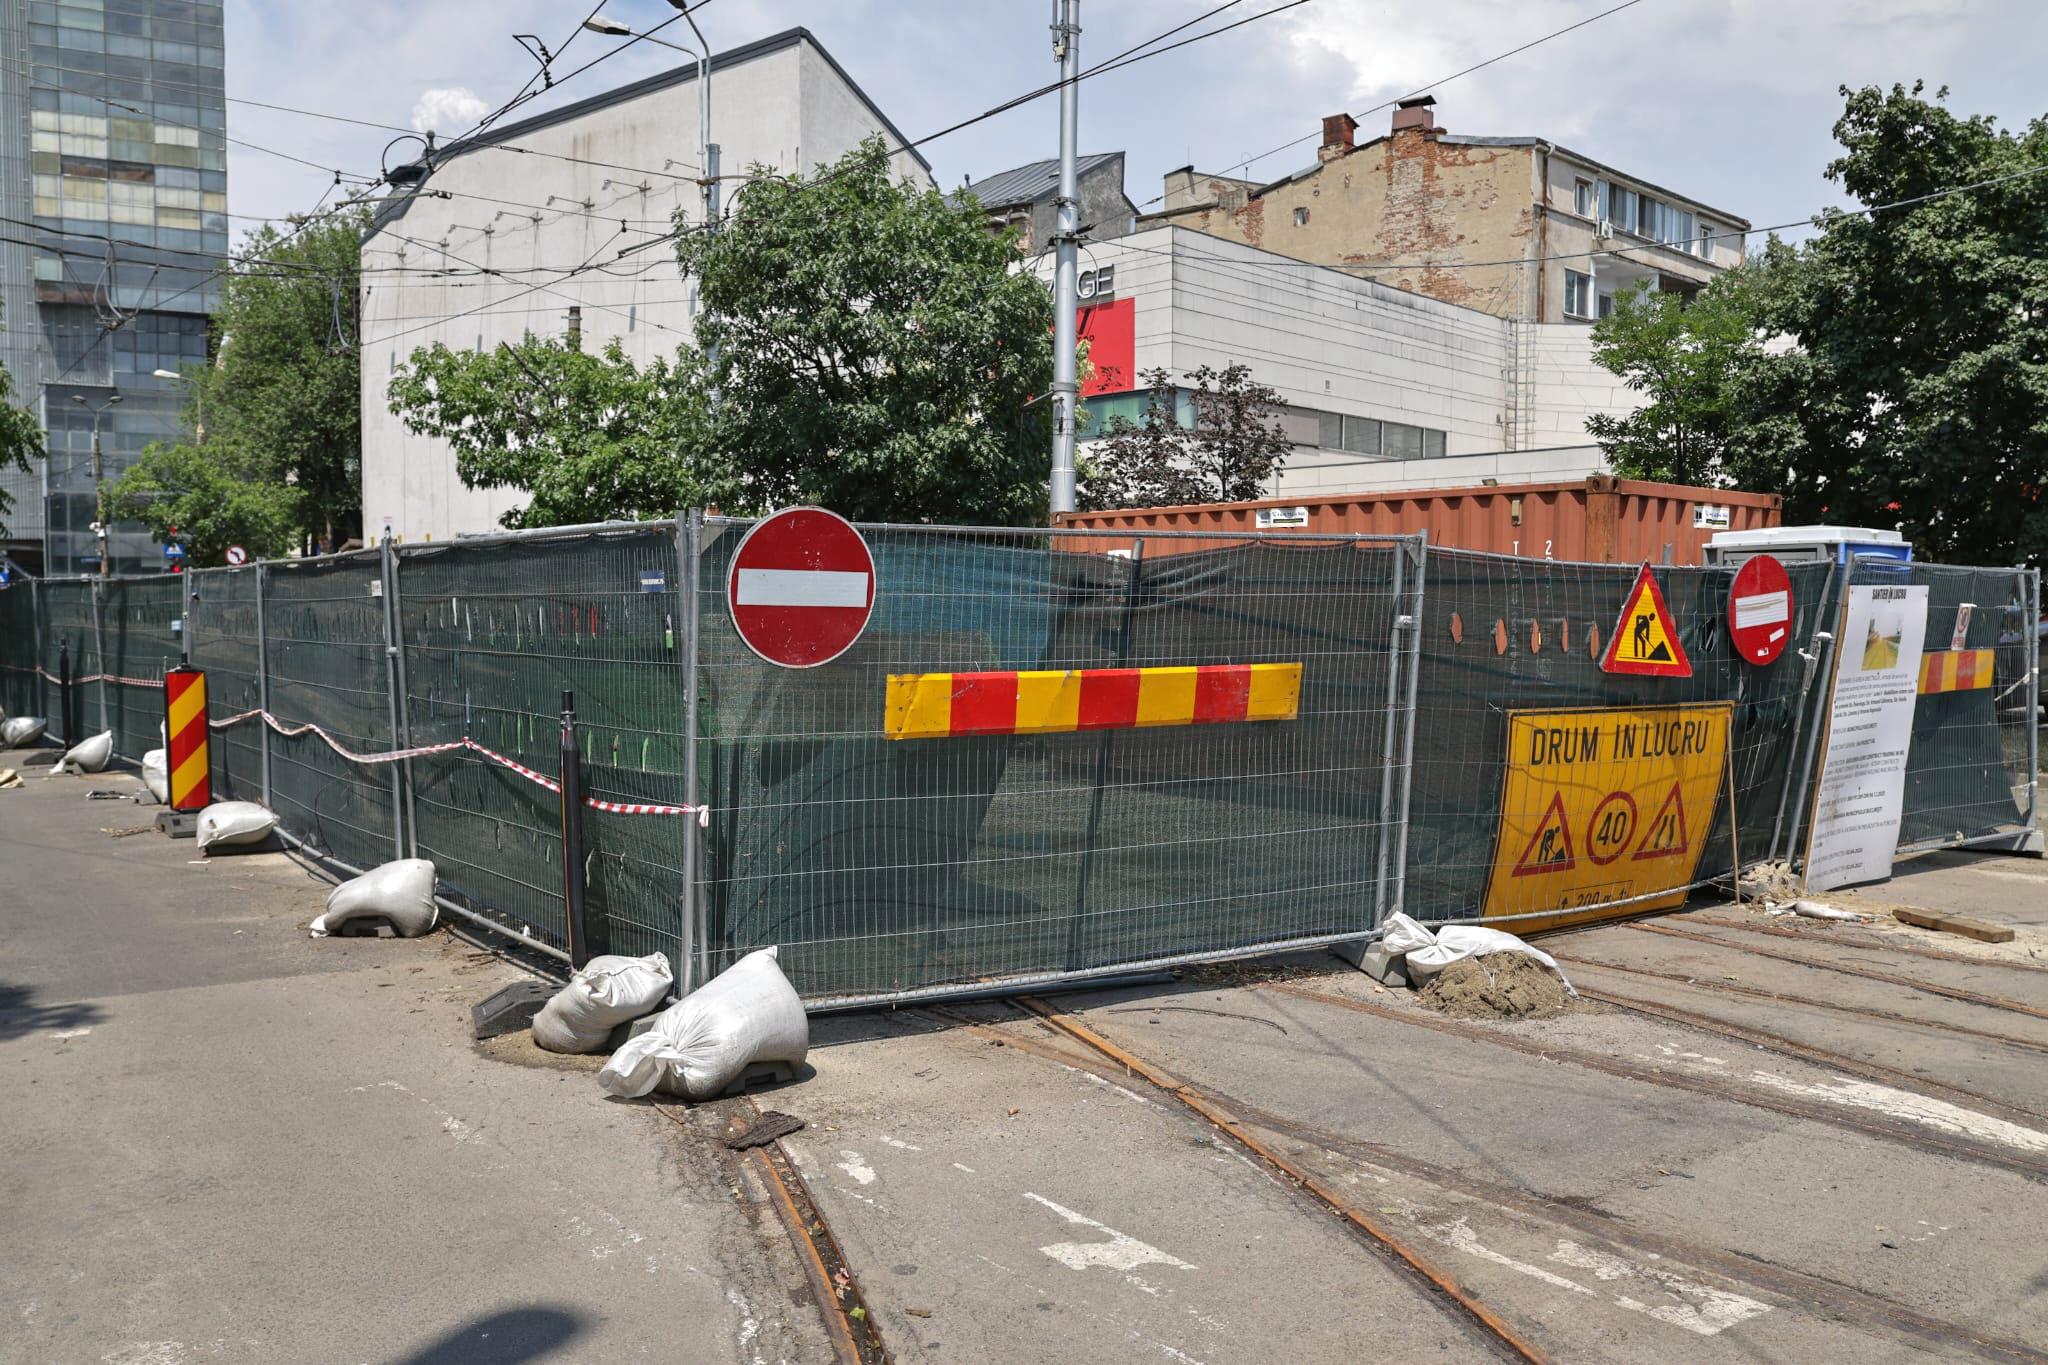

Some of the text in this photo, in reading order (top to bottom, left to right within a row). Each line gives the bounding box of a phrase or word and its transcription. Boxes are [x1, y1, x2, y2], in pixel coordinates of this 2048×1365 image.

[1531, 720, 1709, 765] DRUM IN LUCRU
[1596, 811, 1627, 846] 40
[1576, 890, 1600, 908] 200
